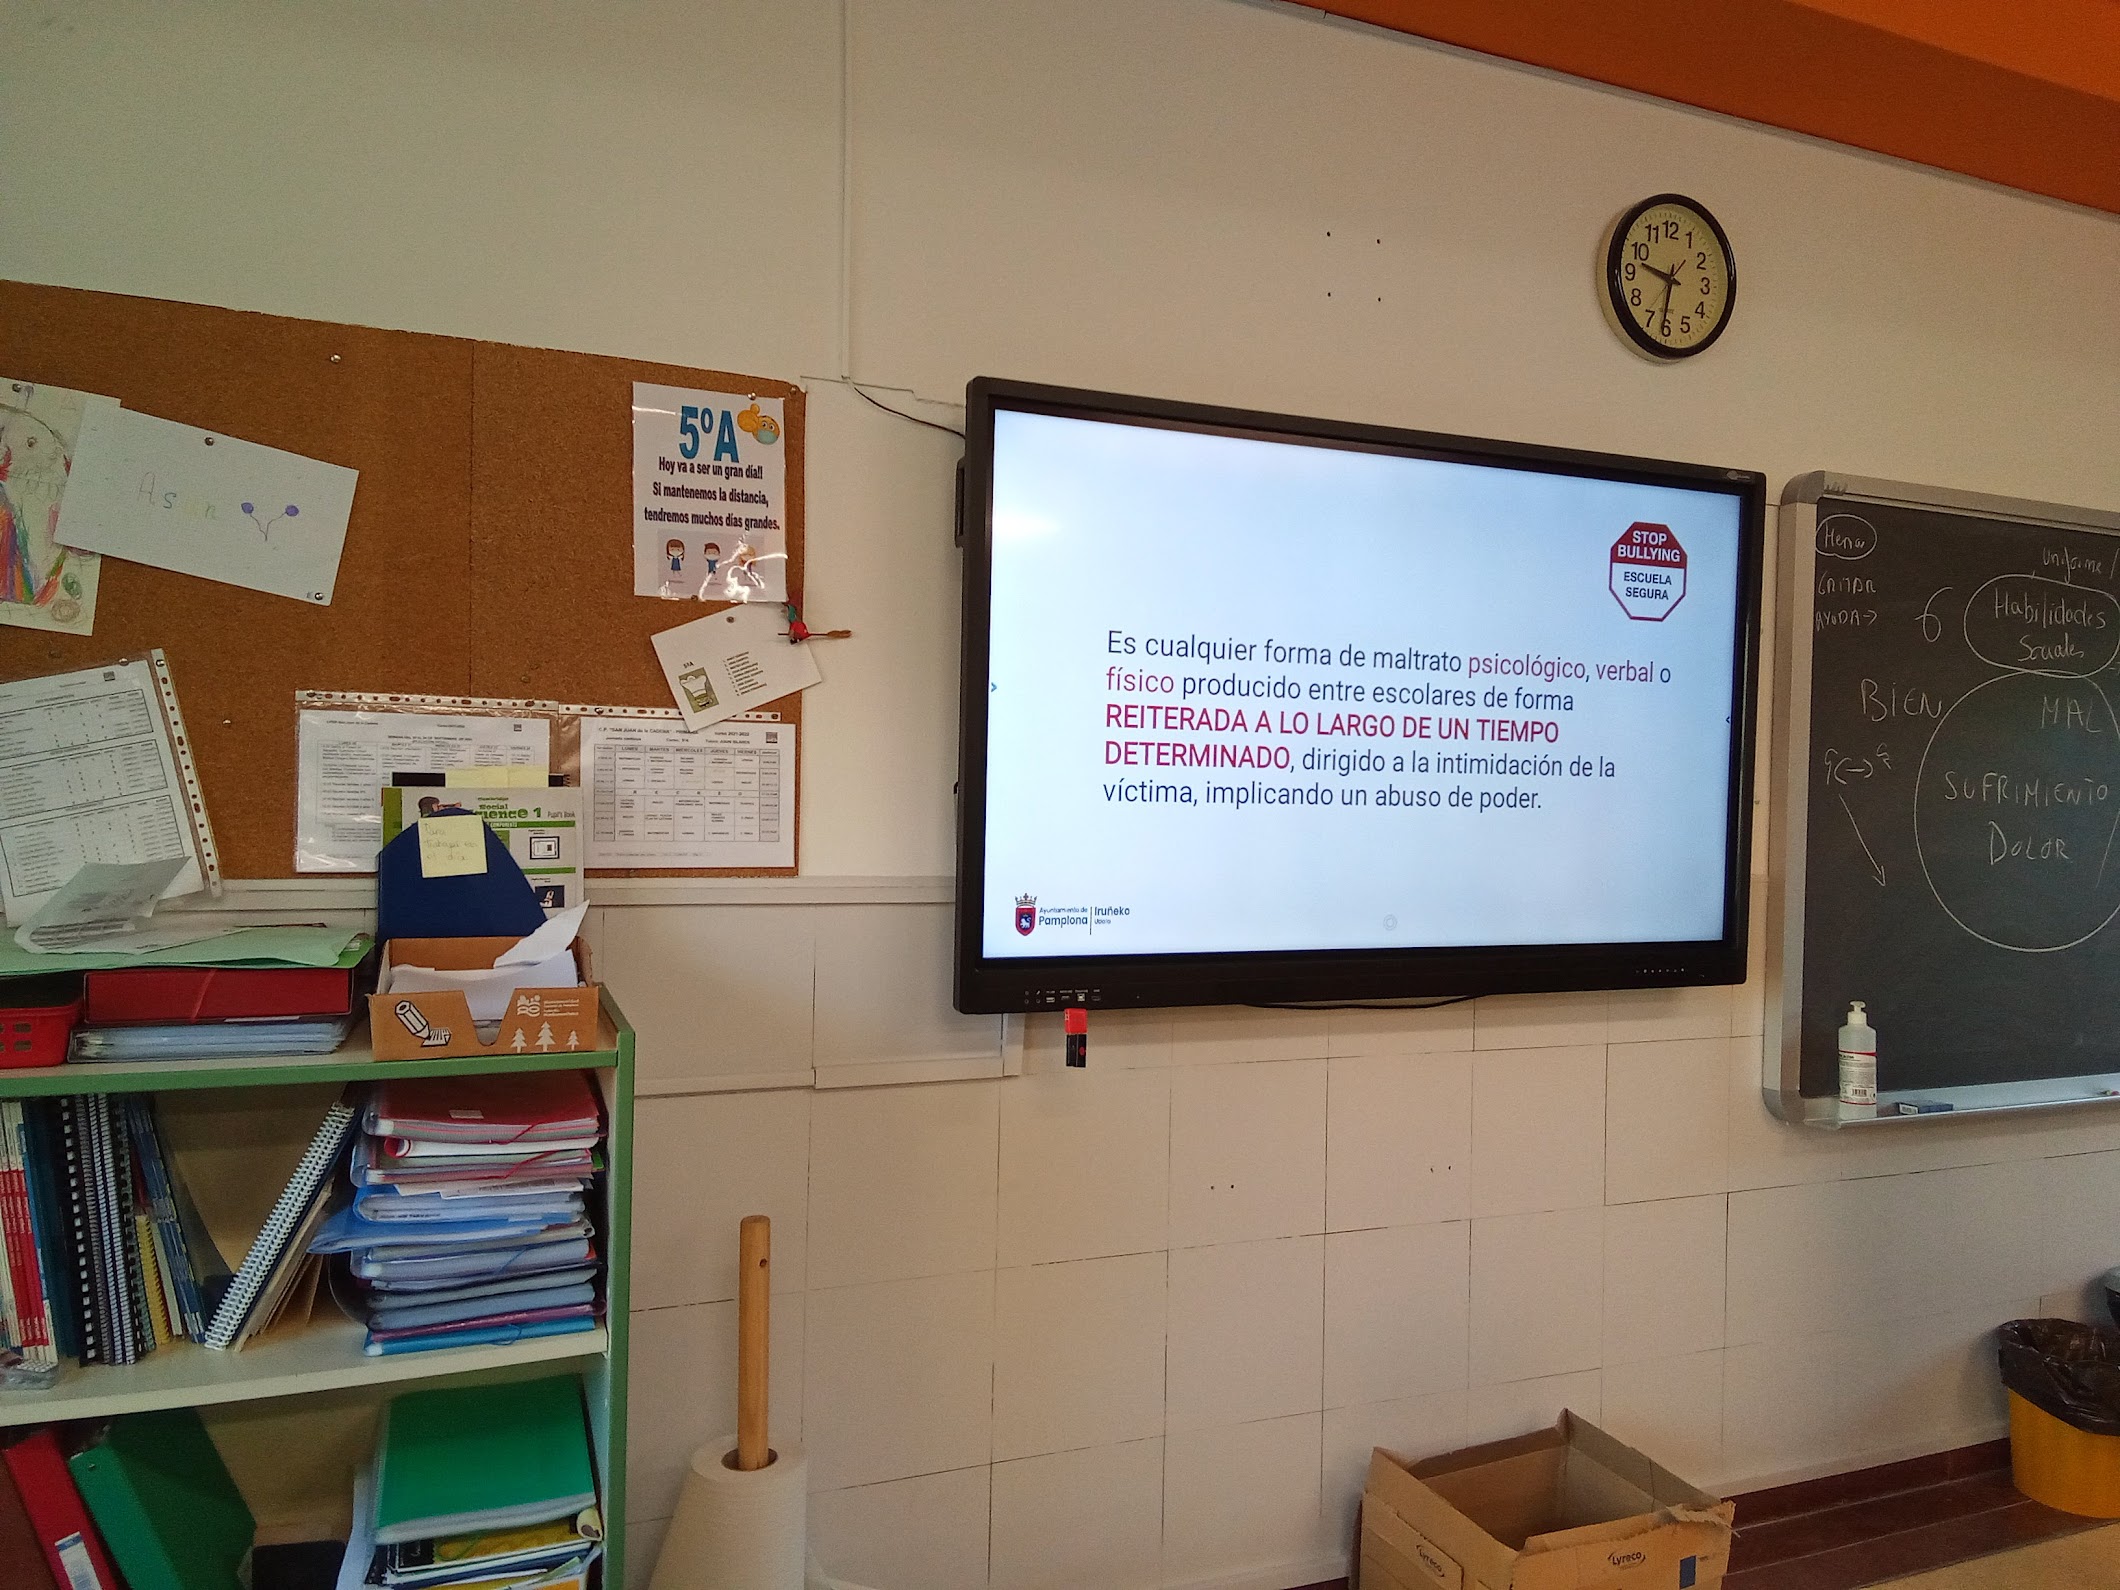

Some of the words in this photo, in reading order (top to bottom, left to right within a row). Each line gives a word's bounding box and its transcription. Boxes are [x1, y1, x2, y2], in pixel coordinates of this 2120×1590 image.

[1645, 224, 1660, 243] 11
[1662, 220, 1679, 240] 12
[1685, 231, 1693, 249] 1
[1631, 242, 1649, 261] 10
[1696, 252, 1706, 270] 2
[1625, 263, 1636, 281] 9
[1700, 277, 1710, 295] 3
[1631, 288, 1642, 306] 8
[1645, 309, 1656, 328] 7
[1695, 301, 1706, 319] 4
[1661, 319, 1672, 337] 6
[1680, 316, 1691, 333] 5
[679, 405, 740, 463] 5ºA
[658, 456, 676, 475] Hoy
[677, 461, 687, 474] va
[689, 463, 695, 474] a
[697, 463, 711, 475] ser
[712, 465, 723, 476] un
[724, 466, 743, 480] gran
[745, 465, 763, 479] día!!
[653, 482, 662, 496] Si
[663, 484, 717, 501] mantenemos
[719, 487, 727, 501] la
[729, 489, 769, 507] distancia,
[644, 507, 689, 524] tendremos
[691, 510, 724, 526] muchos
[725, 514, 743, 528] días
[744, 516, 780, 531] grandes.
[1632, 530, 1667, 546] STOP
[1617, 544, 1680, 562] BULLYING
[1623, 571, 1672, 585] ESCUELA
[1625, 587, 1669, 600] SEGURA
[1994, 587, 2106, 629] Habilidades
[1107, 630, 1136, 654] Es
[1145, 634, 1257, 665] cualquier
[1264, 639, 1331, 666] forma
[1339, 643, 1366, 667] de
[1373, 647, 1462, 672] maltrato
[1468, 653, 1590, 683] psicológico,
[1595, 660, 1654, 682] verbal
[1660, 667, 1671, 683] o
[1106, 665, 1174, 693] físico
[1183, 673, 1301, 700] producido
[1308, 680, 1365, 702] entre
[1372, 683, 1476, 707] escolares
[1483, 685, 1508, 709] de
[1515, 686, 1574, 711] forma
[1106, 703, 1248, 733] REITERADA
[1255, 710, 1272, 733] A
[1280, 711, 1309, 735] LO
[1316, 712, 1395, 737] LARGO
[1402, 716, 1432, 739] DE
[1438, 717, 1469, 740] UN
[1476, 718, 1559, 743] TIEMPO
[2041, 696, 2100, 733] MAL
[1105, 740, 1295, 773] DETERMINADO,
[1302, 747, 1385, 776] dirigido
[1392, 755, 1404, 773] a
[1412, 750, 1429, 773] la
[1436, 752, 1562, 777] intimidación
[1569, 755, 1593, 777] de
[1599, 756, 1615, 777] la
[1103, 778, 1198, 807] víctima,
[1206, 780, 1333, 810] implicando
[1341, 788, 1367, 806] un
[1375, 784, 1441, 807] abuso
[1448, 785, 1473, 808] de
[1480, 787, 1542, 813] poder.
[1944, 771, 2108, 807] SUFRIMIENTO
[475, 807, 528, 819] ience
[534, 806, 541, 819] 1
[1989, 820, 2069, 865] DOLOR
[1094, 906, 1130, 916] Iruñeko
[1039, 915, 1088, 928] Pamplona
[1612, 1551, 1643, 1567] Lyreco
